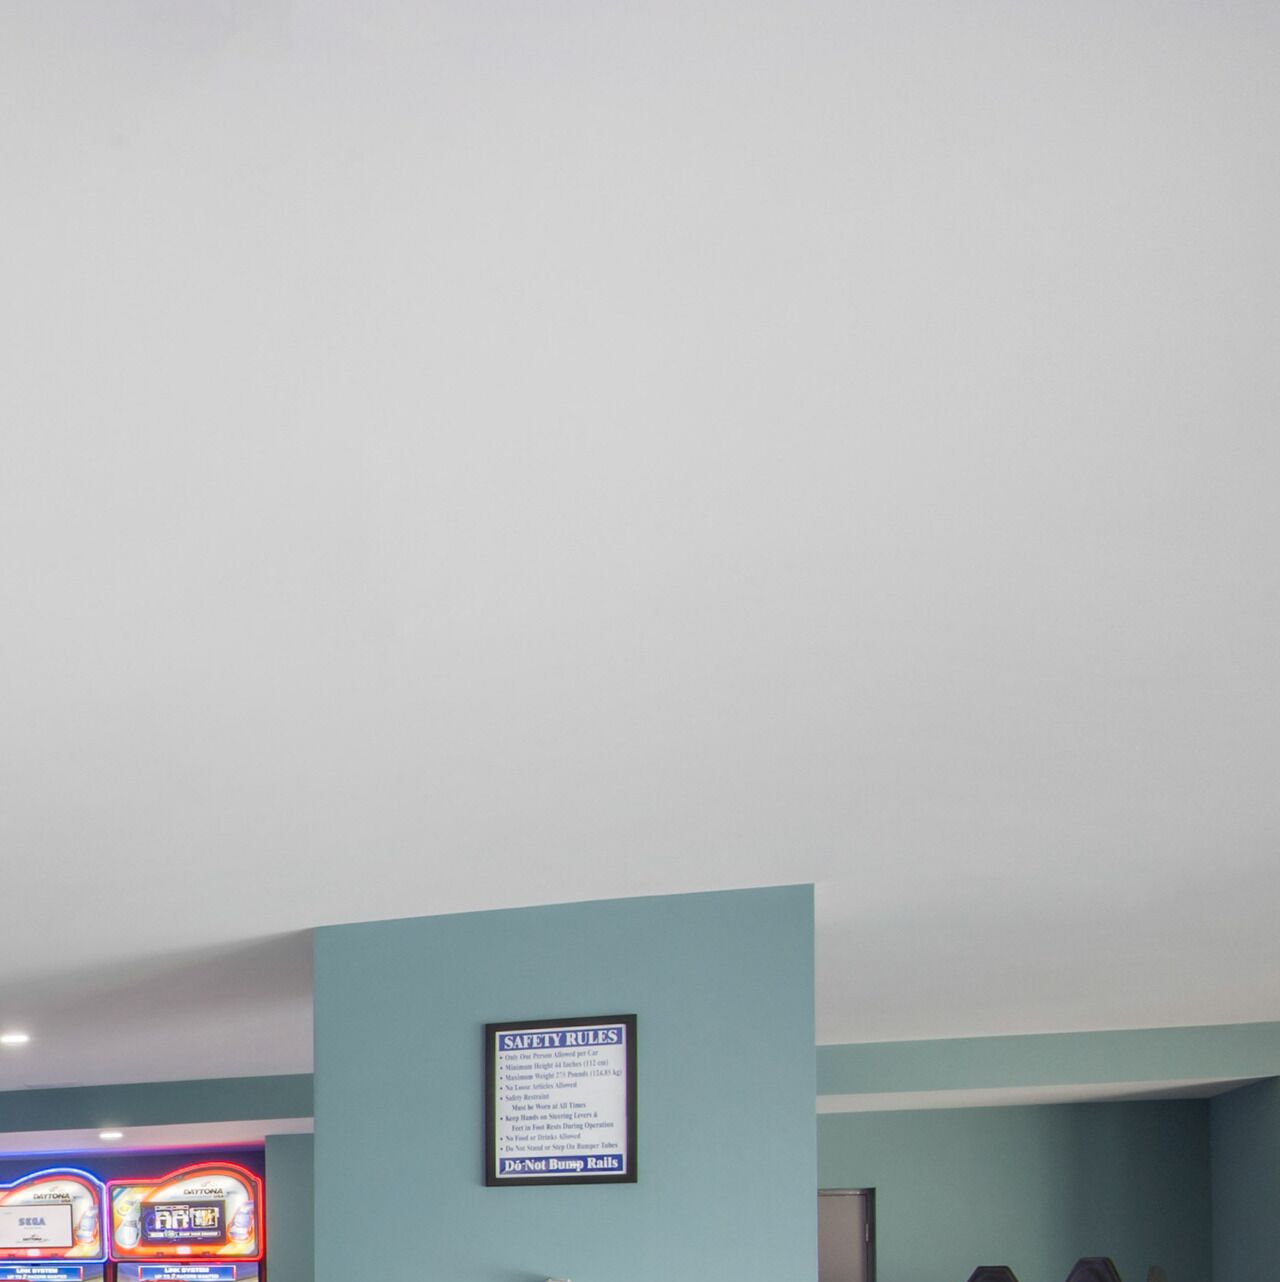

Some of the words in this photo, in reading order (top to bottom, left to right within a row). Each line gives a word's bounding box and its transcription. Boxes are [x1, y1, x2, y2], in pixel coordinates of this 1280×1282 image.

[504, 1032, 562, 1049] SAFETY
[566, 1029, 617, 1046] RULES
[505, 1159, 521, 1171] Do
[525, 1159, 546, 1171] Not
[549, 1158, 583, 1171] Bump
[587, 1157, 618, 1169] Rails
[18, 1217, 46, 1226] SEGA
